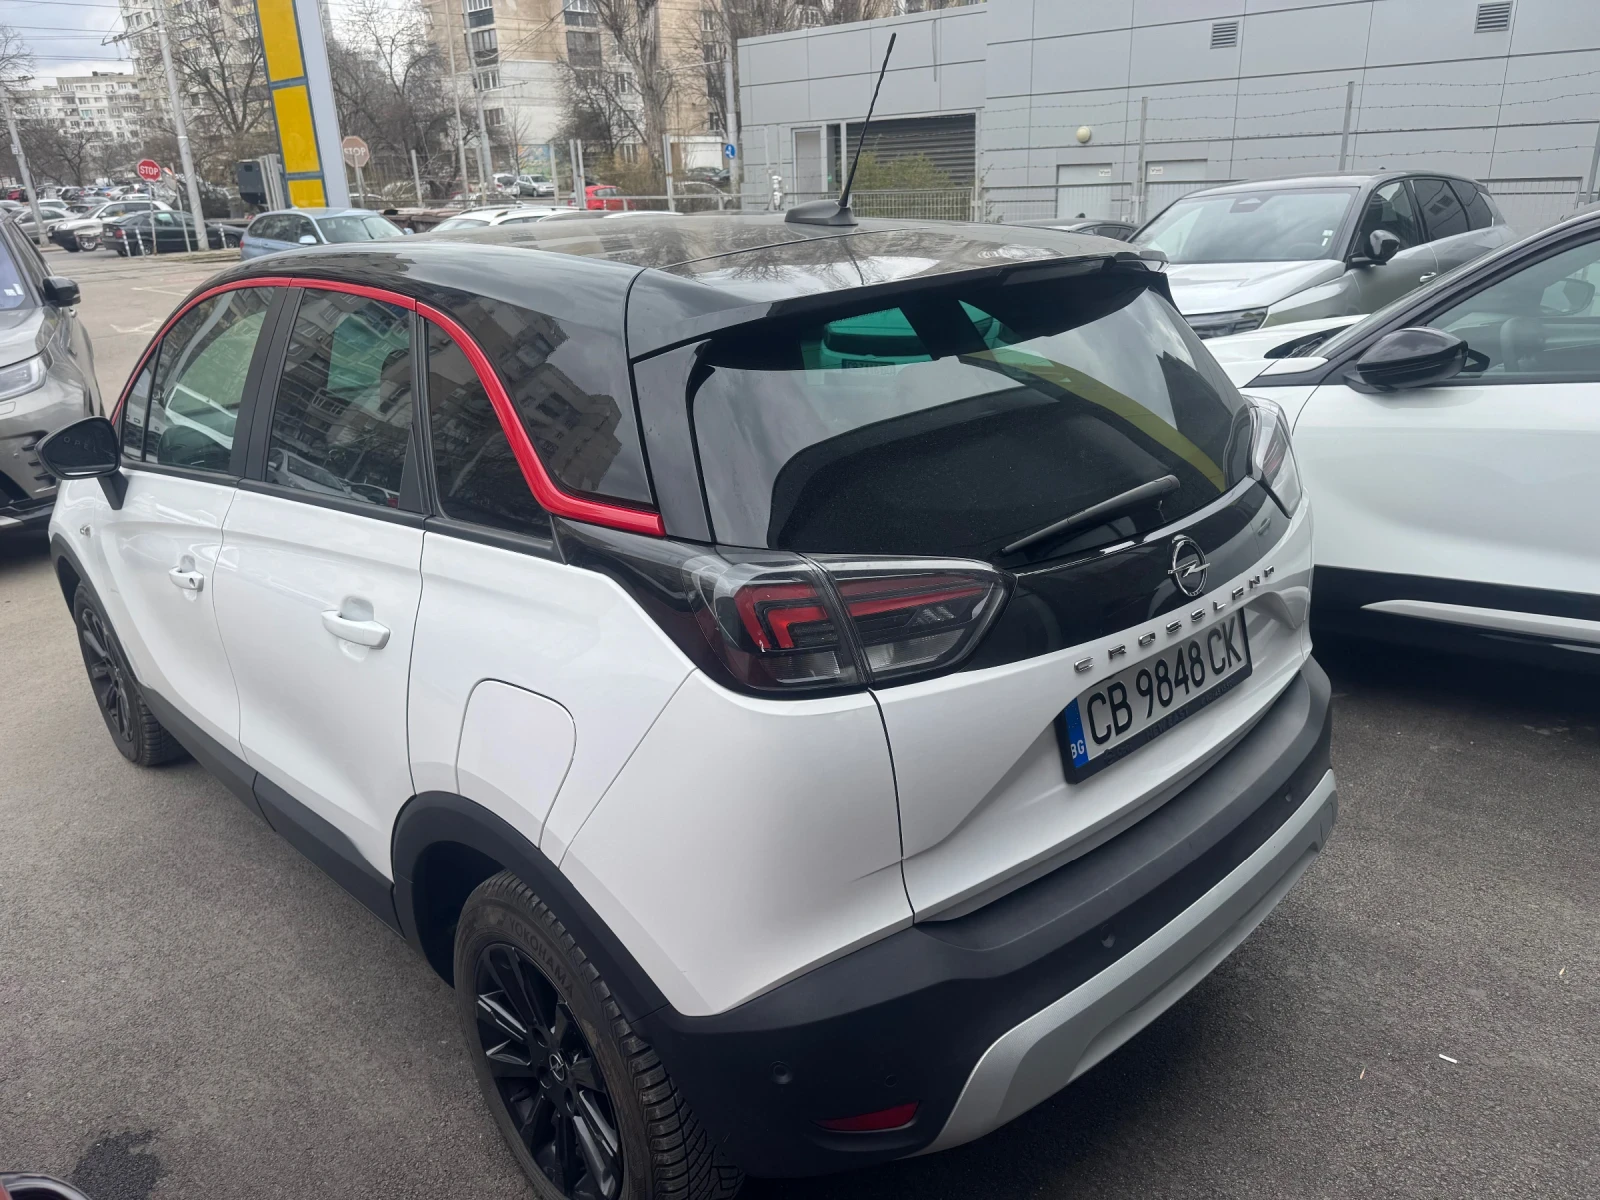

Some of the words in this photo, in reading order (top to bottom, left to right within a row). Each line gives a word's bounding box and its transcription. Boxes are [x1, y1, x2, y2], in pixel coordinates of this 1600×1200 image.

[140, 165, 159, 175] STOP
[1074, 565, 1275, 674] CROSSLAND
[1087, 681, 1133, 745] CB
[1136, 640, 1206, 719] 9848
[1207, 617, 1242, 676] CK
[1070, 739, 1086, 759] BG
[507, 914, 574, 999] YOKOHAMA
